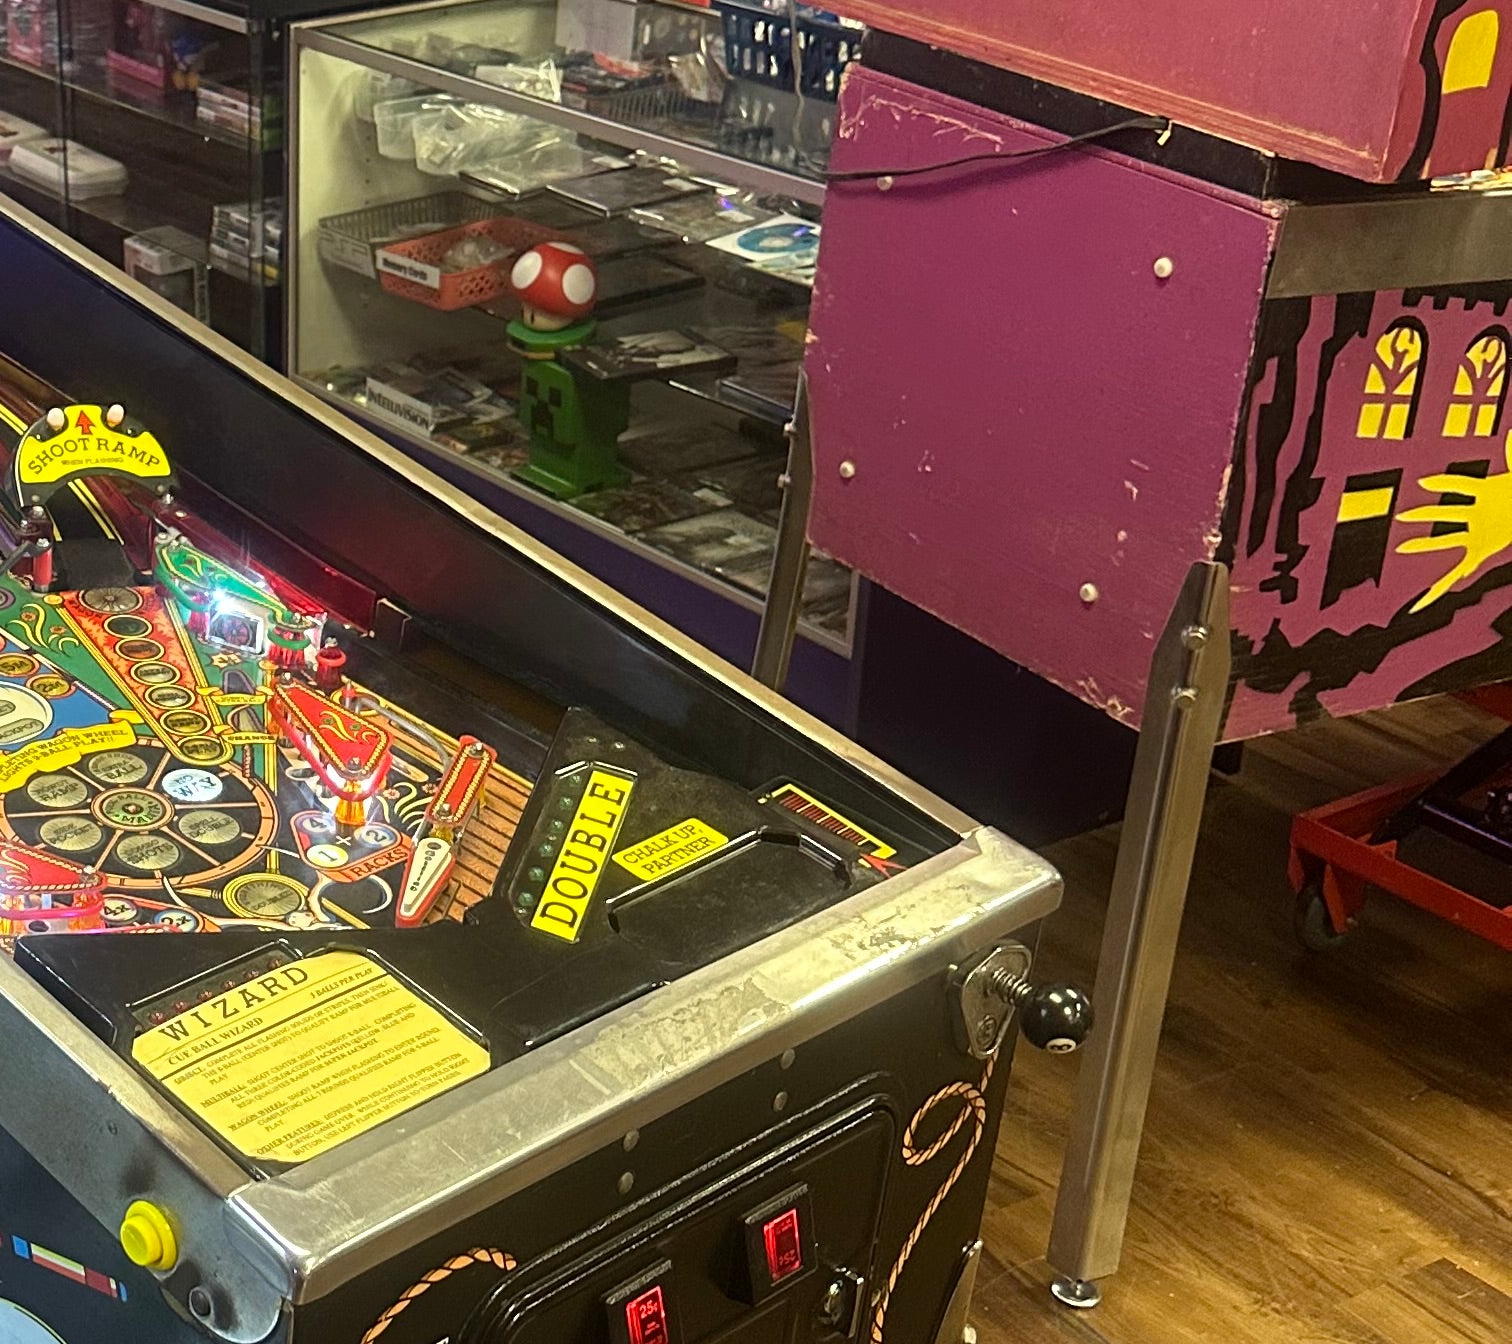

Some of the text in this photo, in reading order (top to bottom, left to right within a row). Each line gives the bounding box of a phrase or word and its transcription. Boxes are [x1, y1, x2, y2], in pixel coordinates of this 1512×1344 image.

[28, 438, 160, 474] SHOOT RAMP
[36, 733, 82, 757] WAGON
[82, 727, 129, 745] WHEEL
[1, 760, 35, 782] LIGHTS
[105, 763, 144, 781] BALL
[365, 829, 387, 843] 2
[622, 823, 703, 865] CHALK UP,
[350, 847, 407, 878] RACKS
[540, 782, 625, 929] DOUBLE
[642, 836, 716, 875] PARTNER
[158, 967, 308, 1041] WIZARD
[168, 968, 373, 1066] CUE BALL WIZARD BALLS PER PLAY
